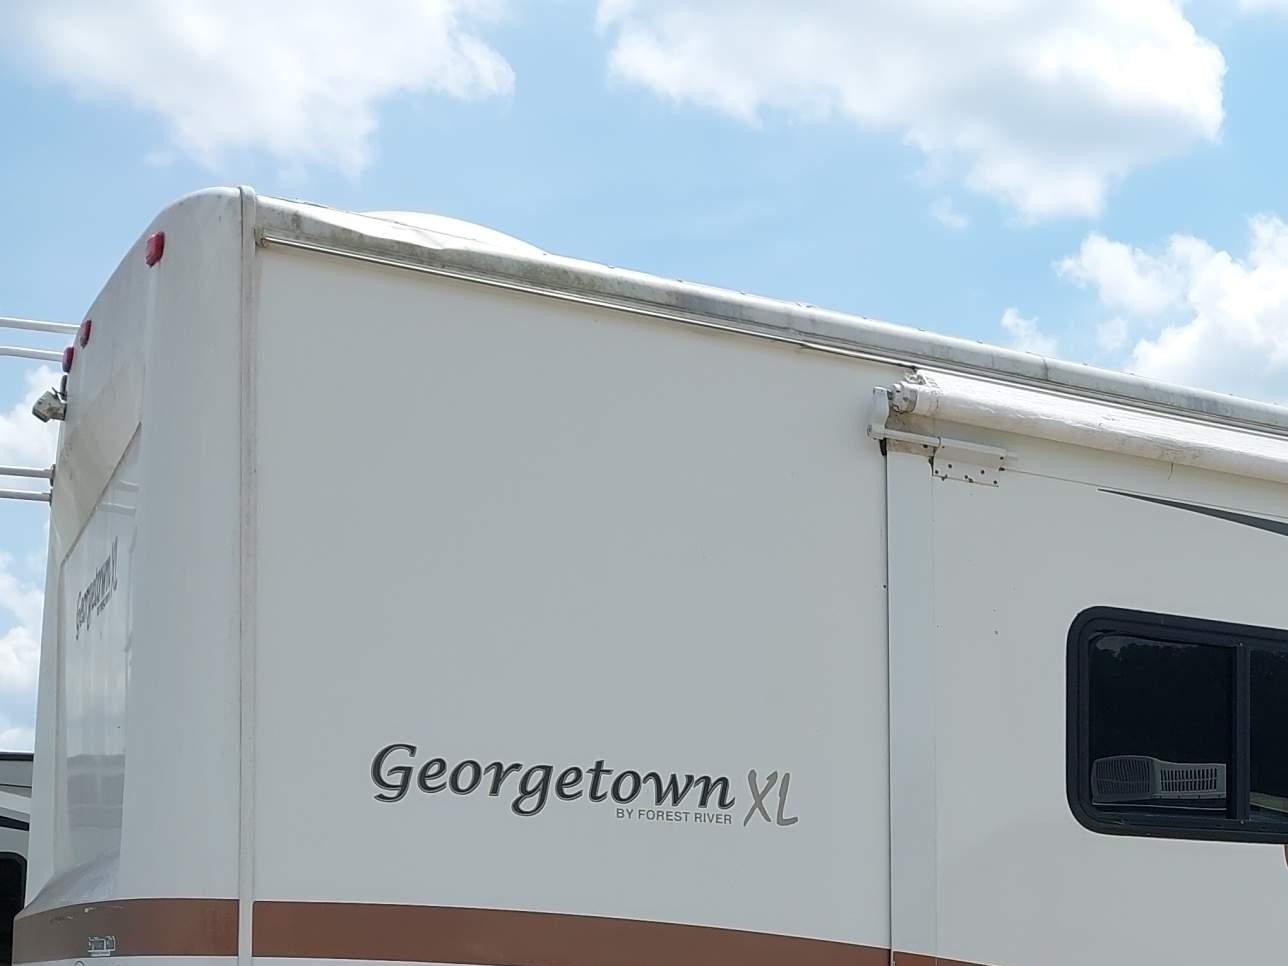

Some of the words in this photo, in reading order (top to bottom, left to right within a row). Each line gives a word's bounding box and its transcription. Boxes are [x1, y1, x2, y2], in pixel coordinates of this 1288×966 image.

[371, 743, 736, 817] Georgetown
[743, 768, 799, 827] XL
[616, 807, 634, 820] BY
[638, 808, 691, 823] FOREST
[694, 811, 732, 825] RIVER
